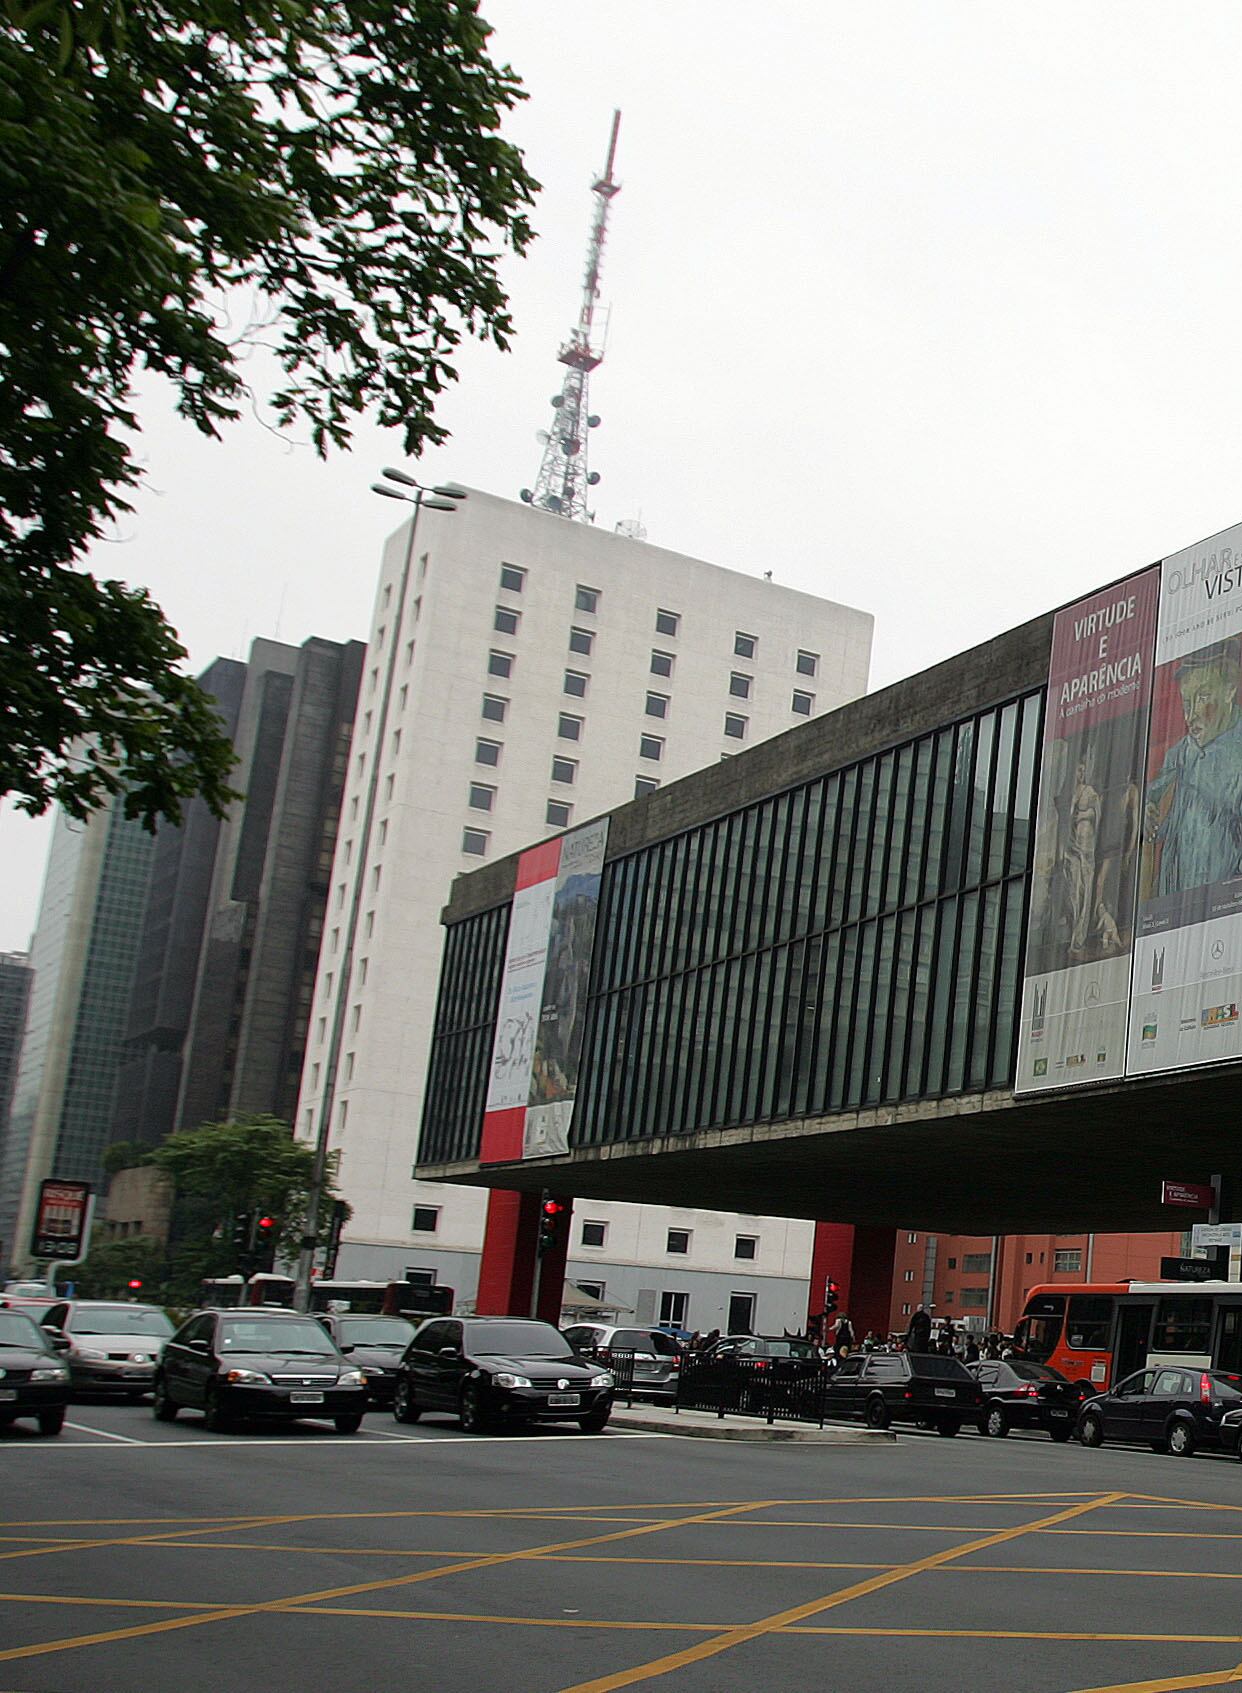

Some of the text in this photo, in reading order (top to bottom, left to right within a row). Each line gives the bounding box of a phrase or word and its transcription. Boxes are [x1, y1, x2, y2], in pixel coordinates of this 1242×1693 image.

[1074, 595, 1136, 642] VIRTUDE
[1098, 635, 1109, 659] E
[1060, 652, 1142, 705] APARÊNCIA
